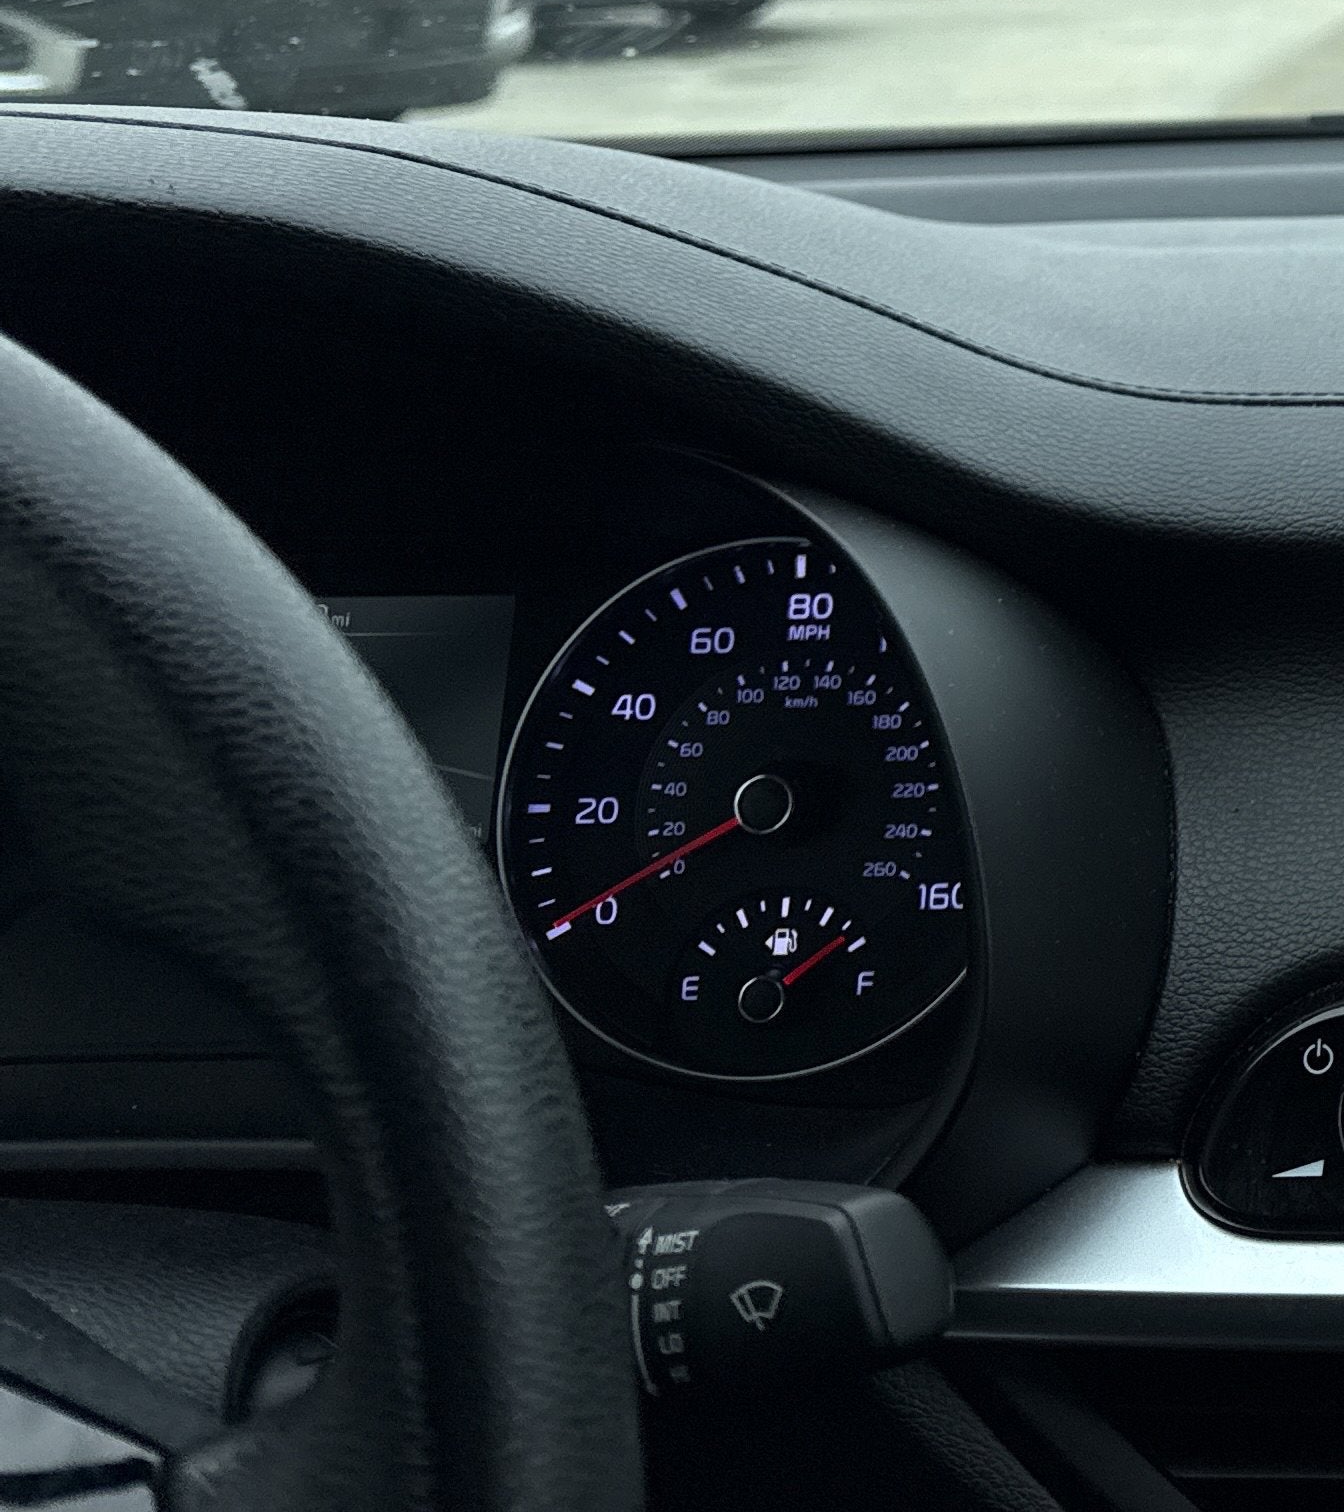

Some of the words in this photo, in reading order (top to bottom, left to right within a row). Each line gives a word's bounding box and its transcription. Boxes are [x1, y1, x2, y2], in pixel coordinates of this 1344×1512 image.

[787, 592, 834, 621] 80
[689, 626, 736, 655] 60
[787, 624, 831, 641] MPH
[773, 675, 801, 691] 120
[814, 674, 842, 690] 140
[737, 688, 765, 704] 100
[783, 695, 819, 709] km/h
[847, 689, 877, 706] 160
[610, 693, 657, 721] 40
[705, 709, 731, 726] 80
[873, 714, 902, 730] 180
[679, 742, 704, 758] 60
[885, 745, 919, 762] 200
[663, 782, 687, 797] 40
[892, 782, 926, 799] 220
[574, 796, 619, 825] 20
[662, 821, 686, 836] 20
[884, 823, 919, 839] 240
[673, 859, 686, 875] 0
[862, 861, 897, 877] 260
[596, 896, 618, 926] 0
[681, 975, 700, 1001] E
[856, 970, 875, 996] F
[652, 1230, 700, 1256] MIST
[651, 1264, 688, 1290] OFF
